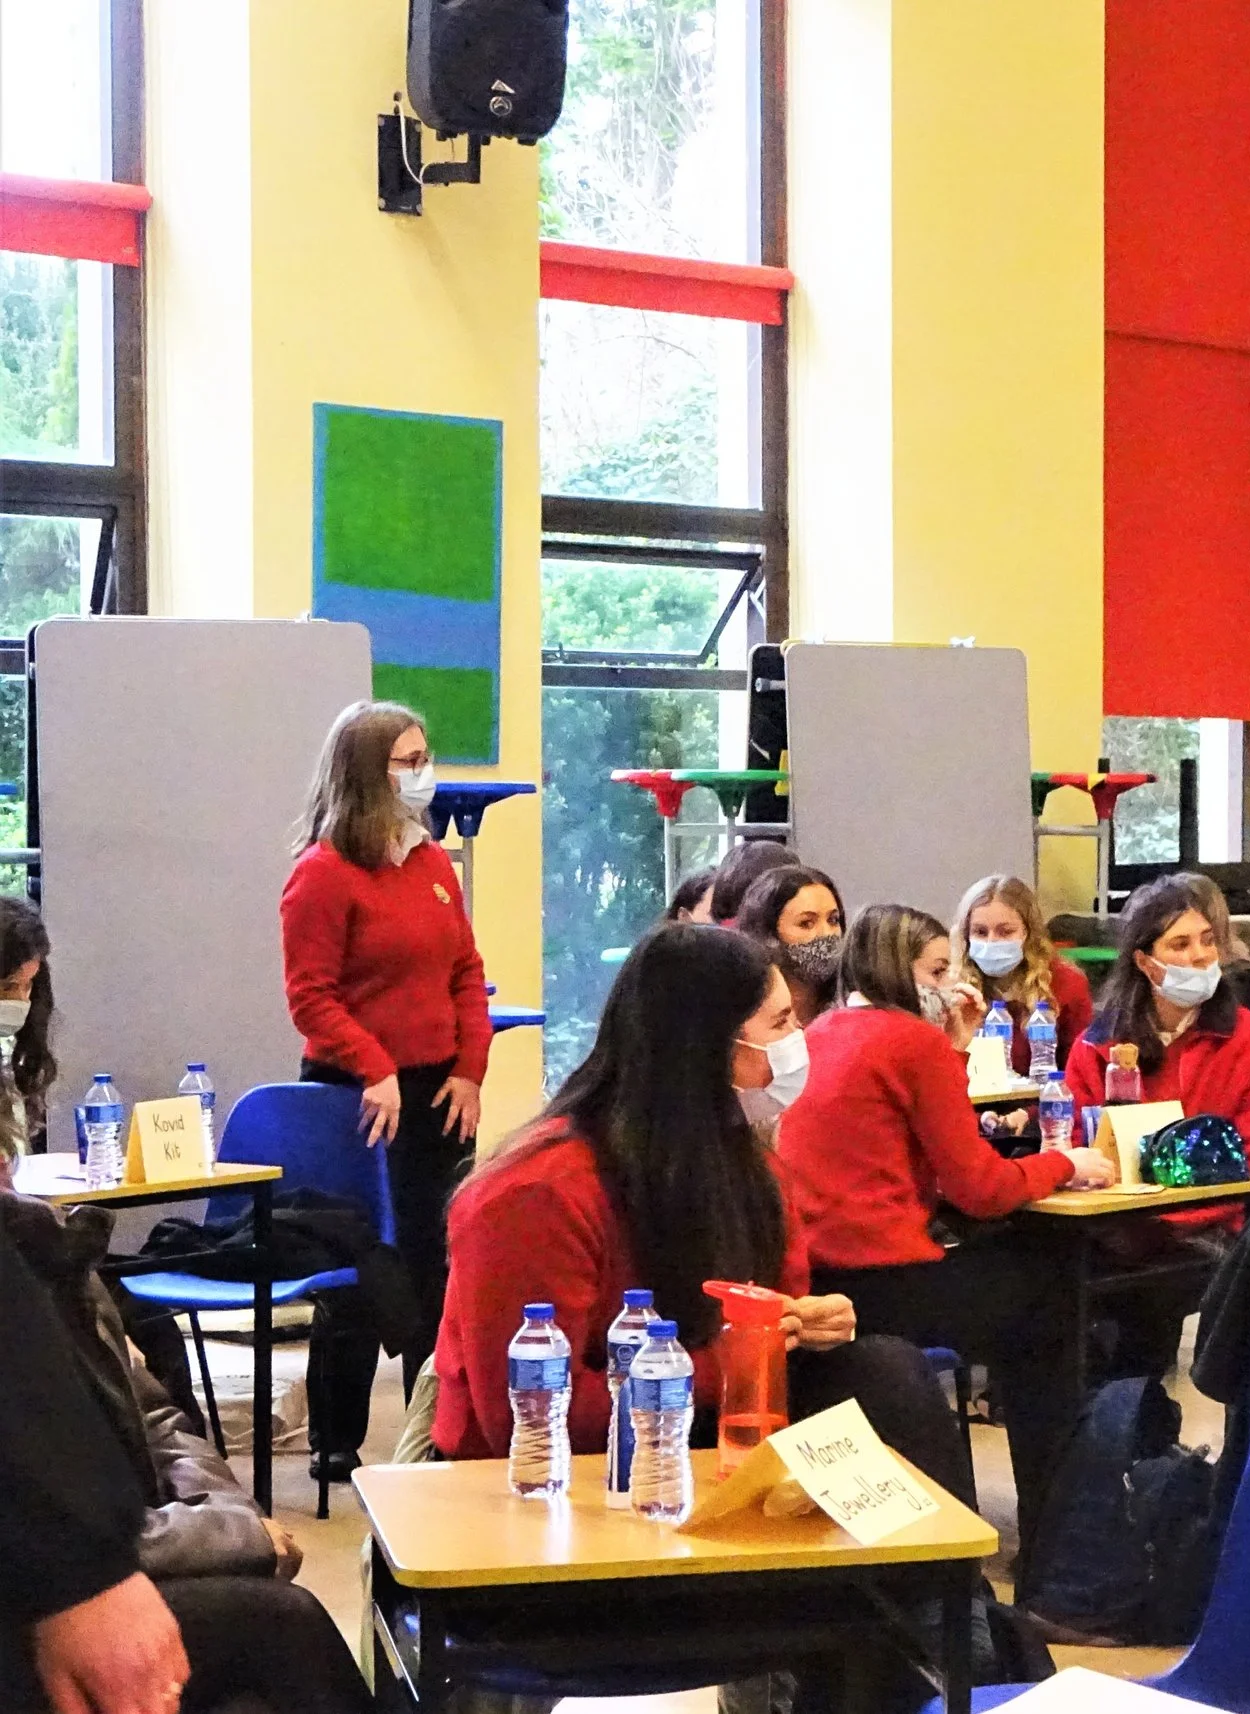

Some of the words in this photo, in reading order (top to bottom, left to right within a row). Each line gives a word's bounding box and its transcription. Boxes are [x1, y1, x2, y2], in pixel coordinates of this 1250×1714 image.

[152, 1113, 185, 1133] Kovid
[164, 1141, 181, 1161] Kit
[796, 1436, 859, 1470] Marine
[819, 1475, 922, 1521] Jewellery
